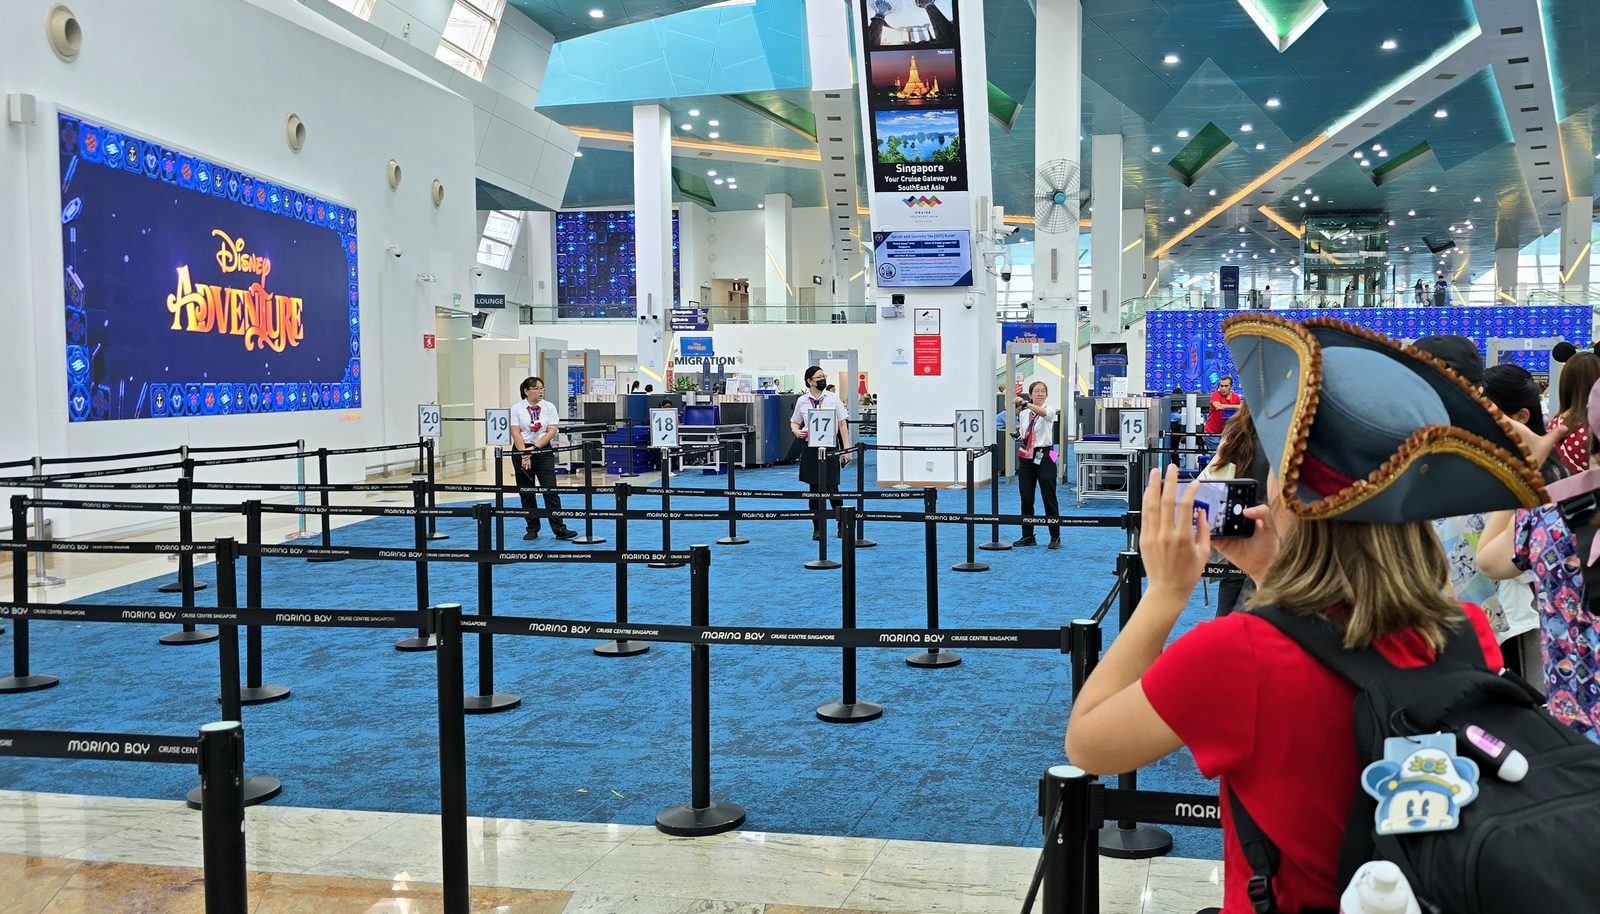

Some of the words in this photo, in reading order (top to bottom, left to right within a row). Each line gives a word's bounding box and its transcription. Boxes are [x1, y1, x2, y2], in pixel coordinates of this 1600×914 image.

[896, 164, 944, 174] Singapore
[212, 229, 271, 288] Disney
[166, 264, 304, 352] ADVENTURE
[423, 412, 439, 424] 20
[490, 417, 507, 431] 19
[655, 417, 673, 431] 18
[812, 418, 831, 431] 17
[960, 418, 979, 433] 16
[1123, 420, 1142, 434] 15
[12, 607, 28, 615] BAY
[122, 610, 156, 619] MARINA
[159, 611, 176, 619] BAY
[276, 613, 311, 622] MARINA
[314, 614, 332, 623] BAY
[529, 622, 568, 633] MARINA
[571, 625, 590, 634] BAY
[702, 631, 741, 640] MARINA
[745, 632, 765, 641] BAY
[879, 633, 920, 642] MARINA
[924, 633, 945, 643] BAY
[67, 740, 119, 753] MARINA
[125, 742, 150, 754] BAY
[159, 746, 180, 754] CRUISE
[1175, 802, 1220, 819] MARI
